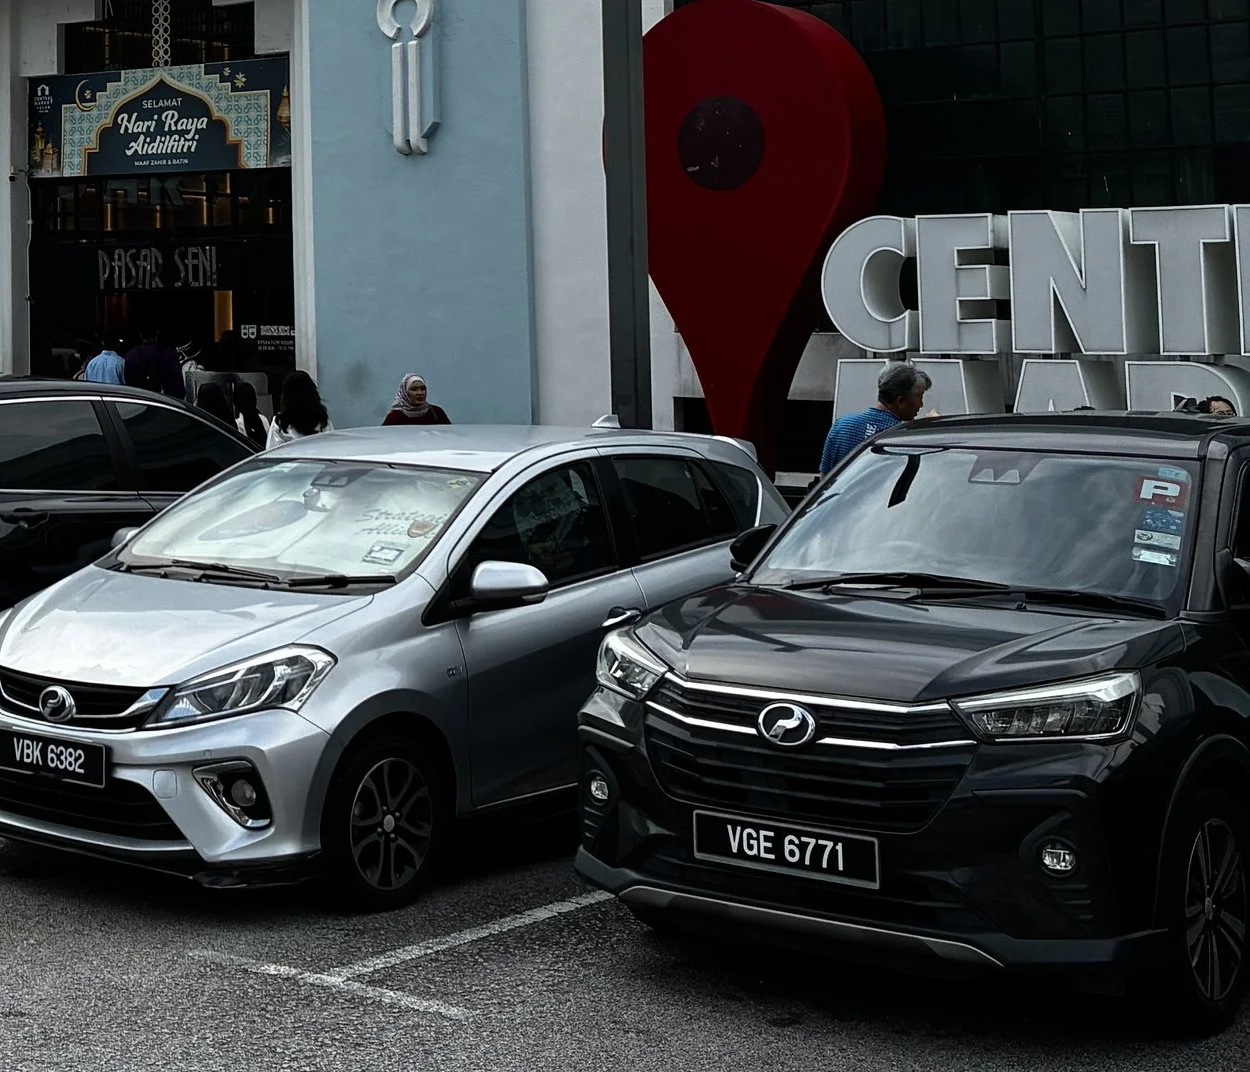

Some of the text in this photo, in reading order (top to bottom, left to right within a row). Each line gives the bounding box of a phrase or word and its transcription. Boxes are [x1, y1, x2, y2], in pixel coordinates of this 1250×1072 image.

[142, 98, 182, 108] SELAMAT
[117, 110, 209, 139] Hari Raya
[125, 134, 199, 156] Aidilfitri
[98, 245, 217, 289] PASAR SENI
[821, 205, 1250, 355] CENT
[1140, 479, 1180, 499] P
[13, 736, 85, 774] VBK 6382
[727, 824, 844, 872] VGE 6771
